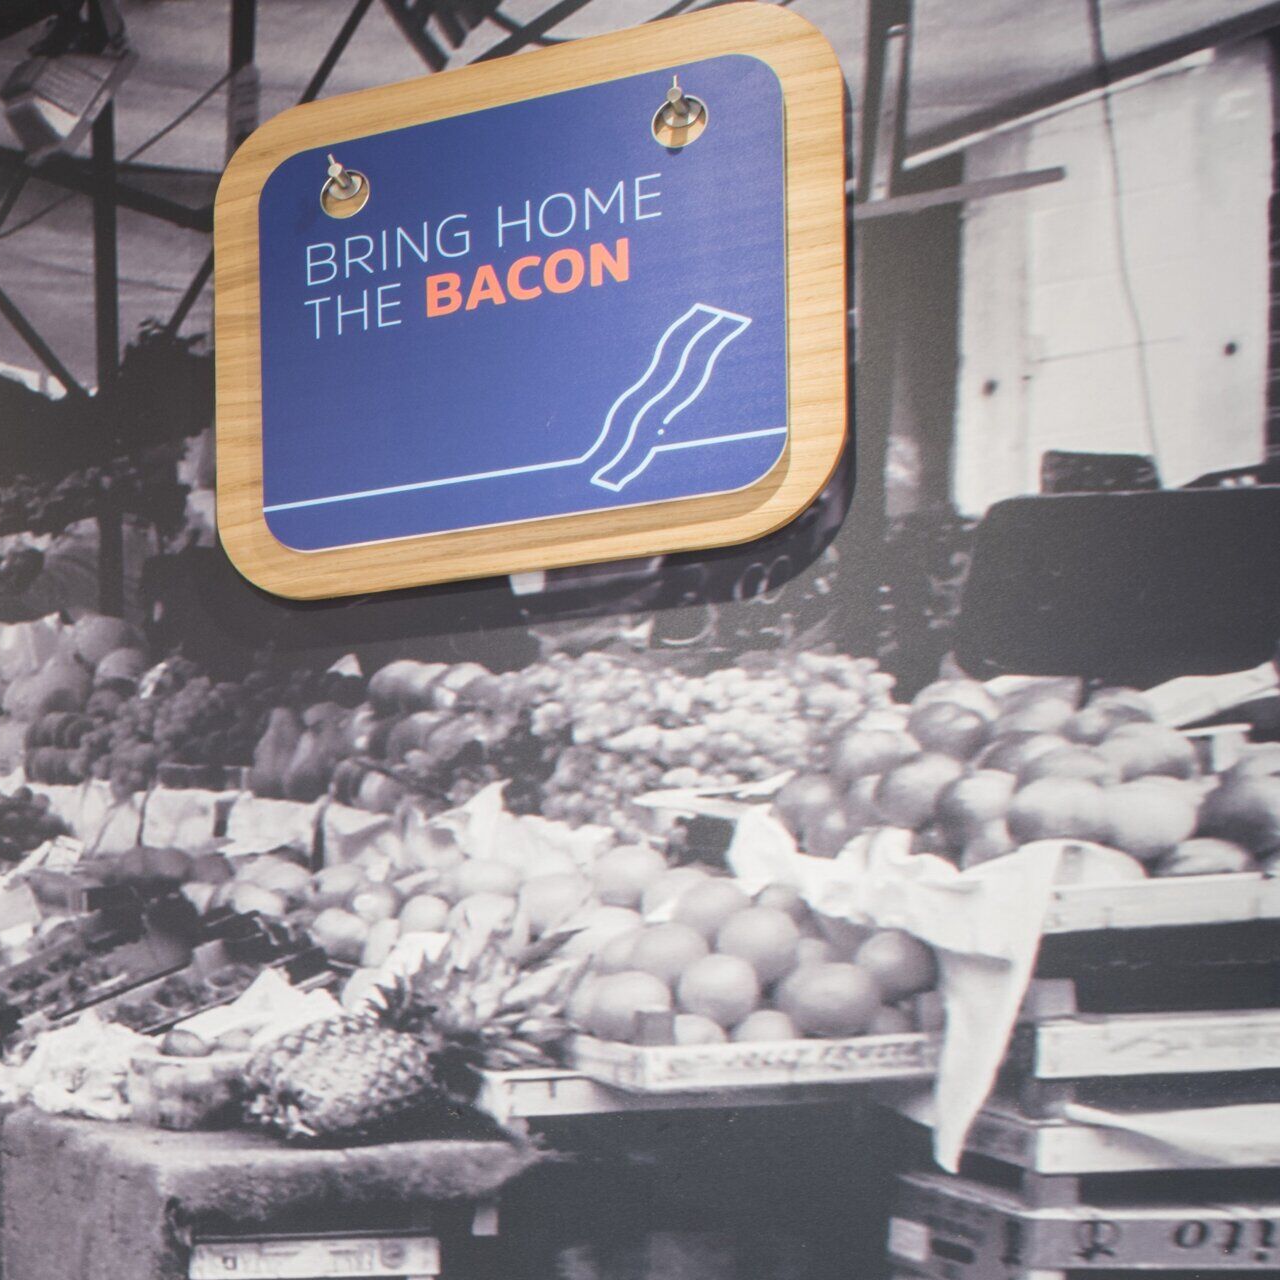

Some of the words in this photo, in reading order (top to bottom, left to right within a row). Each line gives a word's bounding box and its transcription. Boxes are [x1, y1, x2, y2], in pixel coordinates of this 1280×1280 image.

[304, 213, 470, 287] BRING
[497, 173, 663, 246] HOME
[304, 282, 402, 341] THE
[424, 237, 631, 319] BACON
